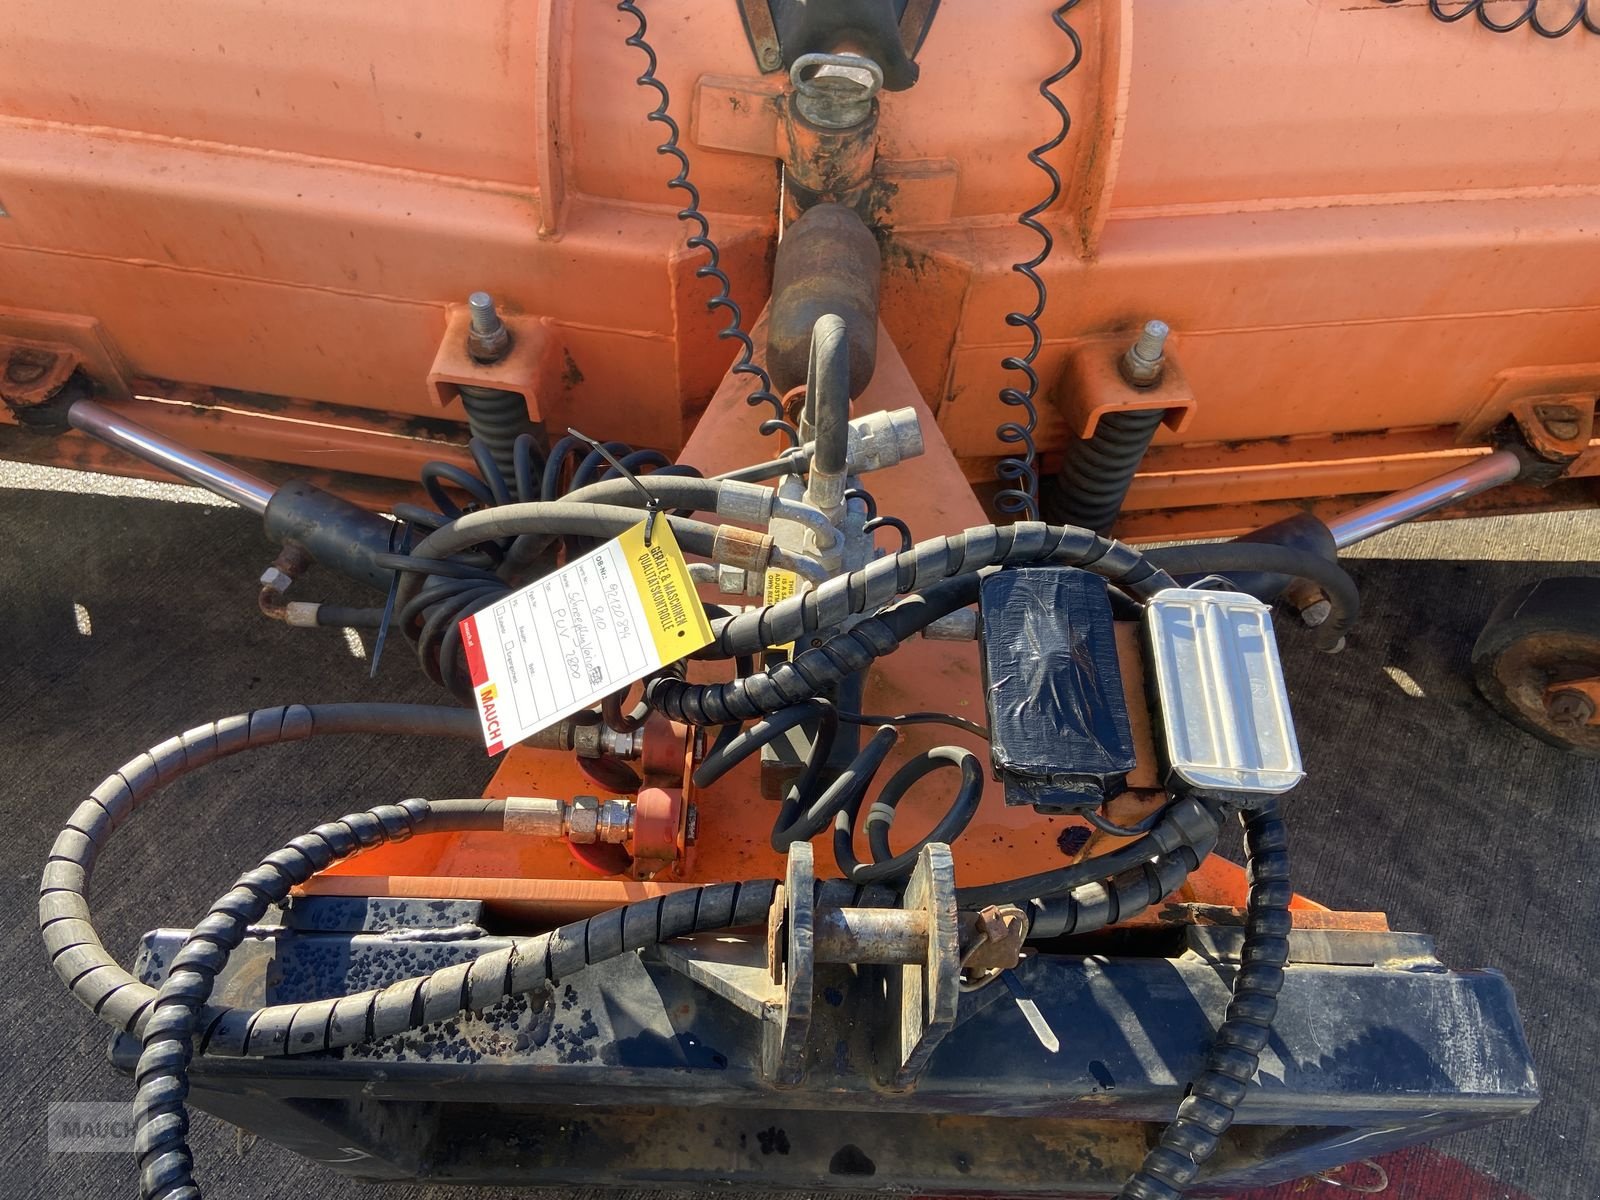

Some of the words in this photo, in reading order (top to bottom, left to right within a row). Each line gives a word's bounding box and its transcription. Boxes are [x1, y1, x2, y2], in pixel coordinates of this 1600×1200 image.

[650, 545, 668, 574] GERÄTE
[638, 552, 675, 632] QUALITÄTSKONTROLLE
[658, 573, 671, 582] &
[591, 604, 606, 630] 810
[663, 580, 688, 626] MASCHINEN
[552, 607, 569, 638] PUV
[480, 689, 502, 741] MAUCH
